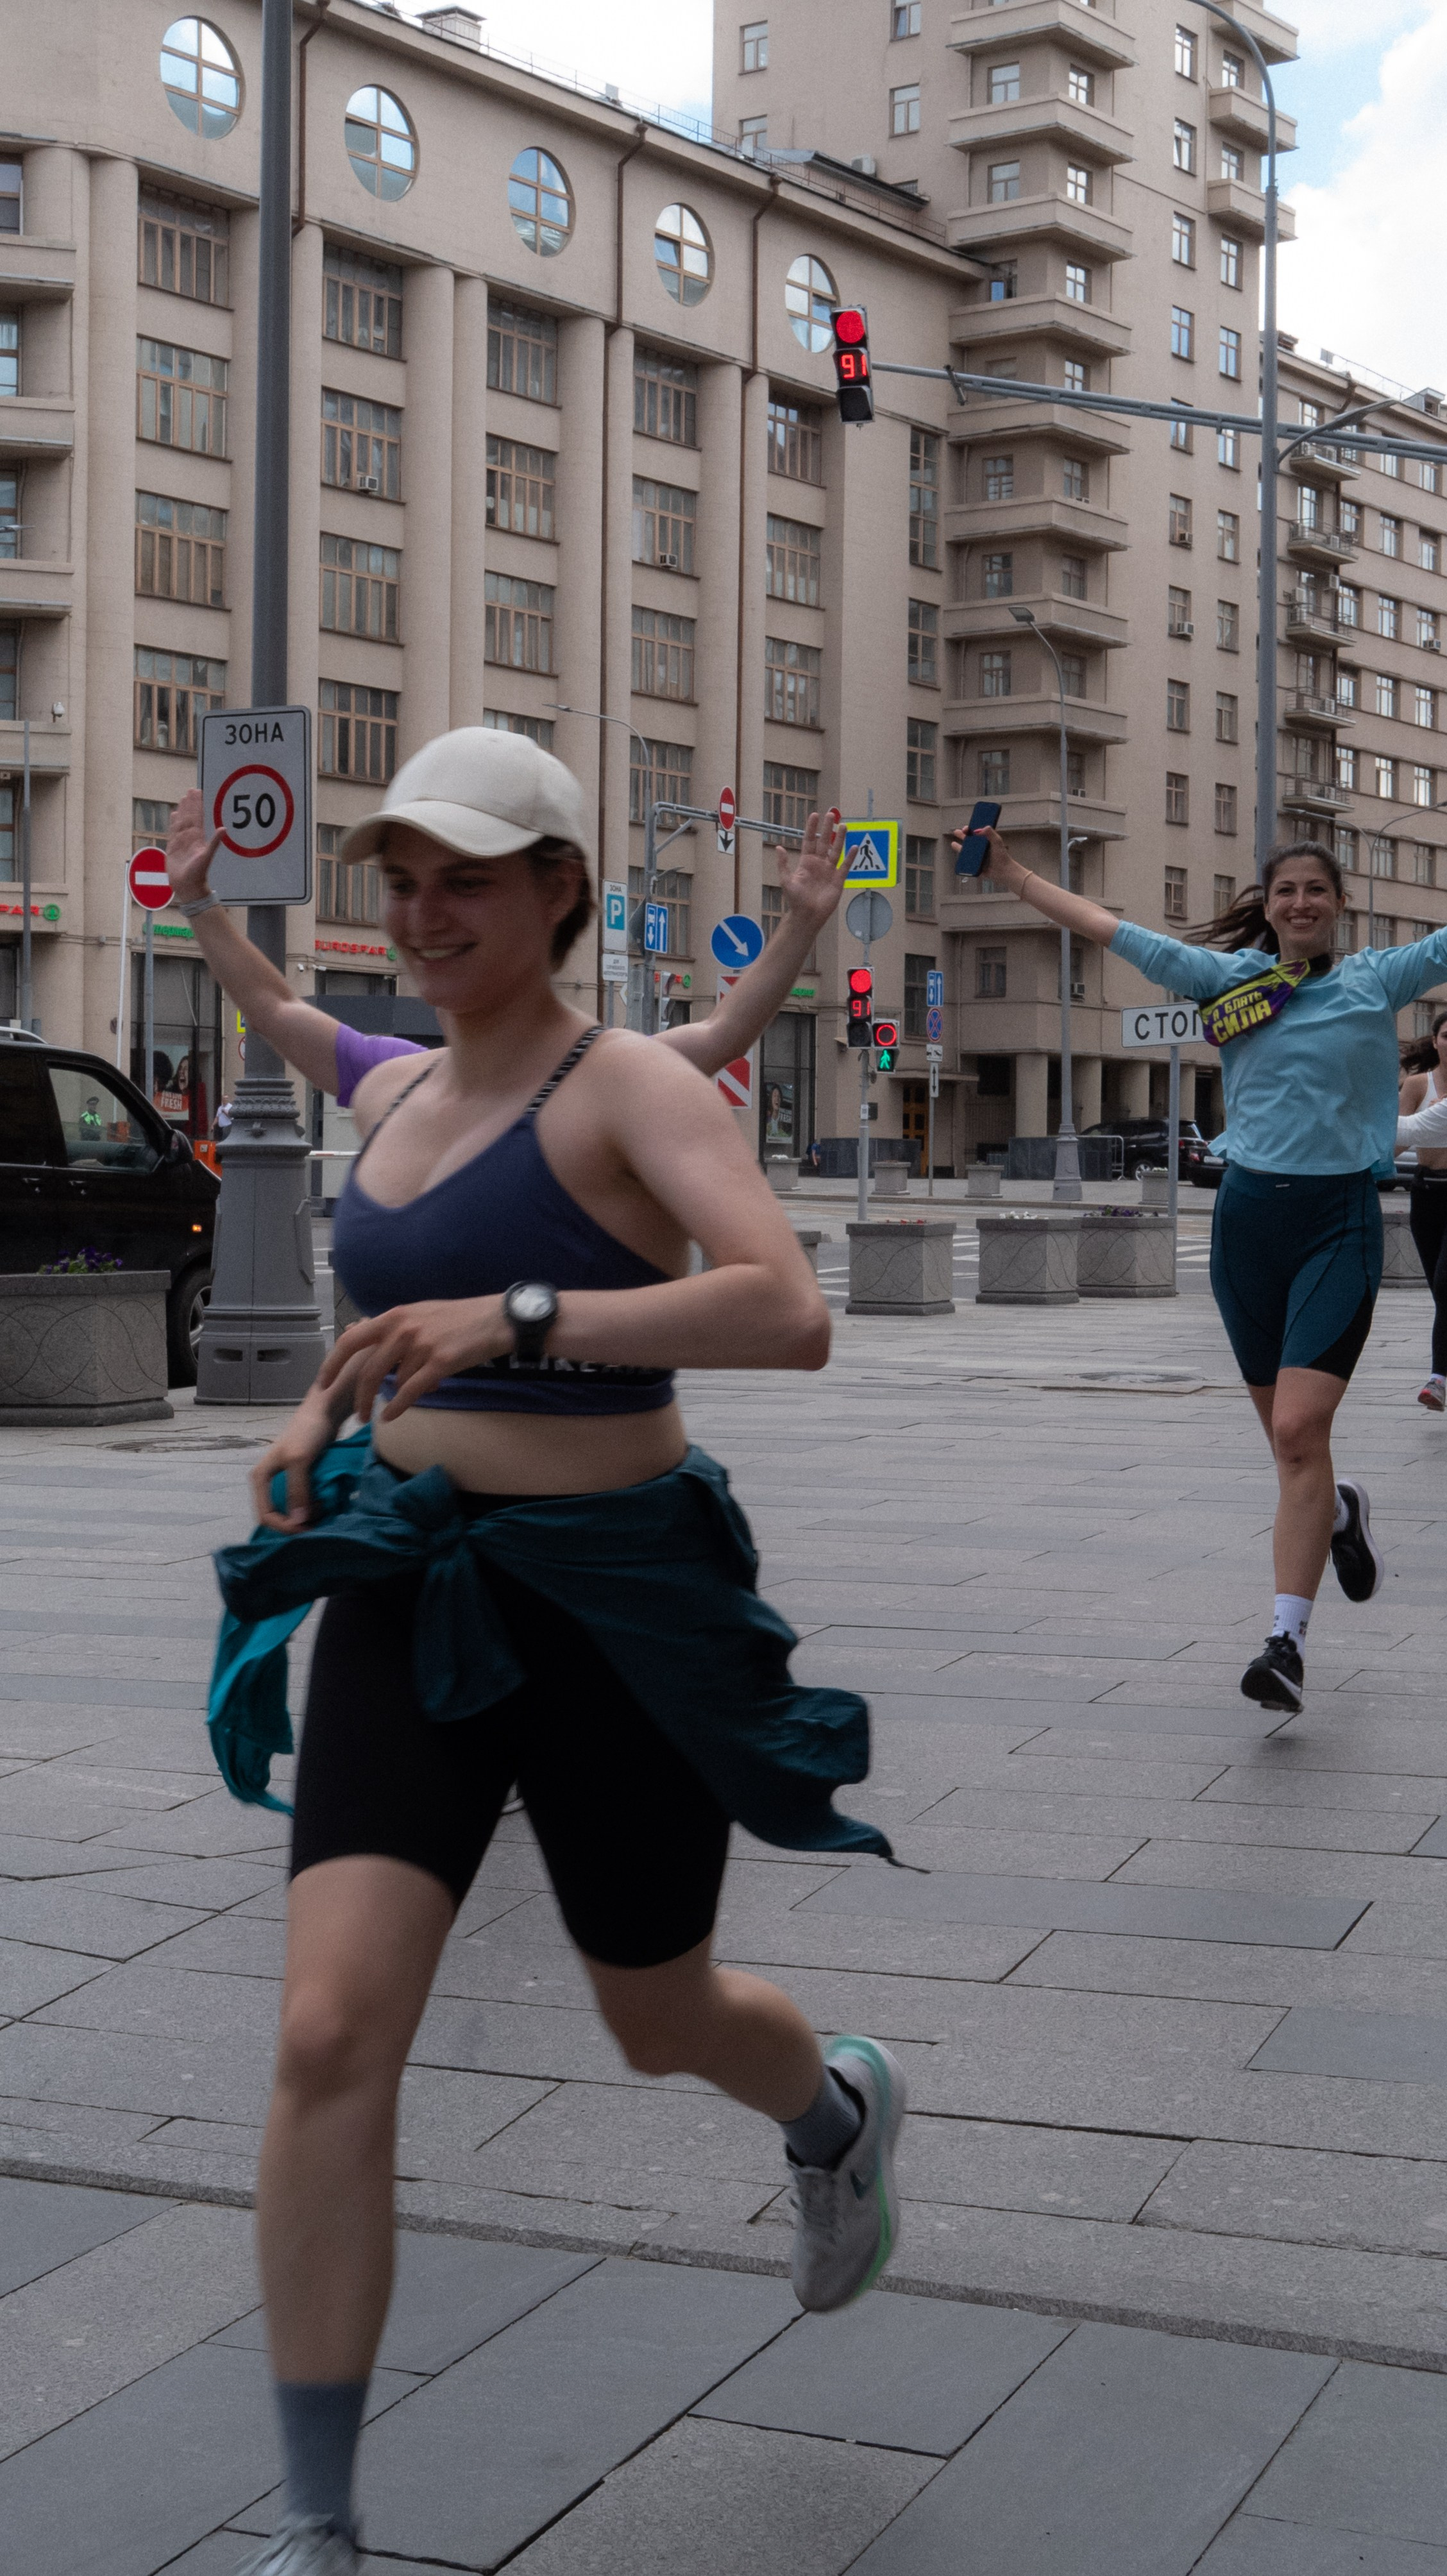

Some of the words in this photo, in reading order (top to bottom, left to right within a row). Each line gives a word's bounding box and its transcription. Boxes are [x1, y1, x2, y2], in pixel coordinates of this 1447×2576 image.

[841, 354, 867, 379] 91
[224, 722, 284, 745] ЗОНА
[232, 793, 276, 829] 50
[609, 885, 622, 893] ЗОНА
[314, 939, 386, 956] EUROSPAR
[852, 1000, 871, 1017] 91
[1224, 991, 1263, 1014] БЛЯТЬ
[1212, 999, 1273, 1044] СИЛА
